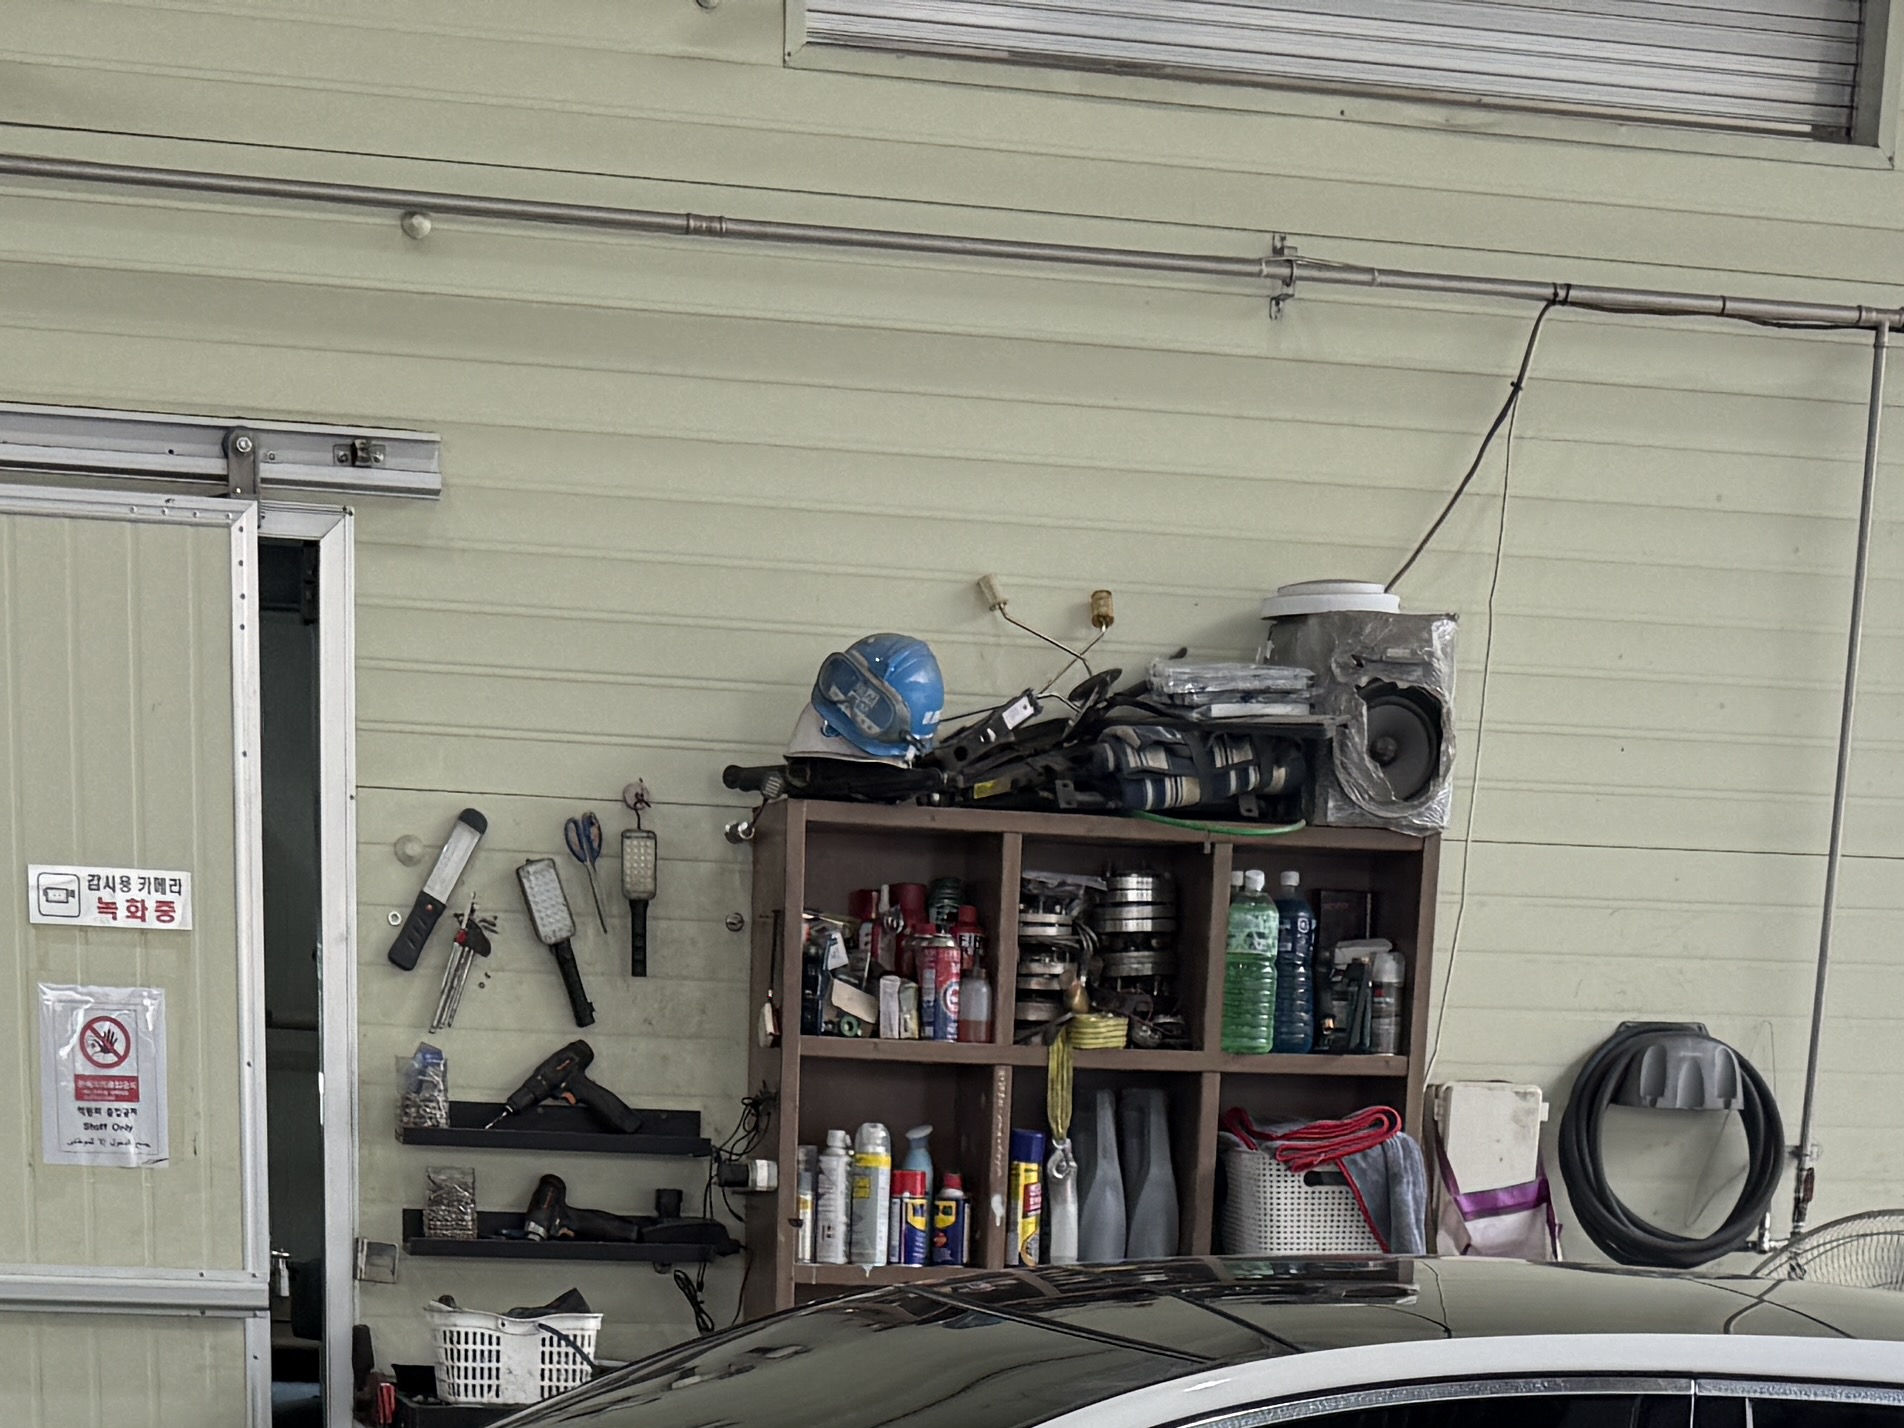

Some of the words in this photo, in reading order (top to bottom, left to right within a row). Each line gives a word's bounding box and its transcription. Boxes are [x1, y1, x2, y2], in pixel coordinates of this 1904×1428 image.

[87, 873, 132, 893] 감시용
[137, 875, 182, 896] 카메라
[96, 896, 176, 923] 녹화중
